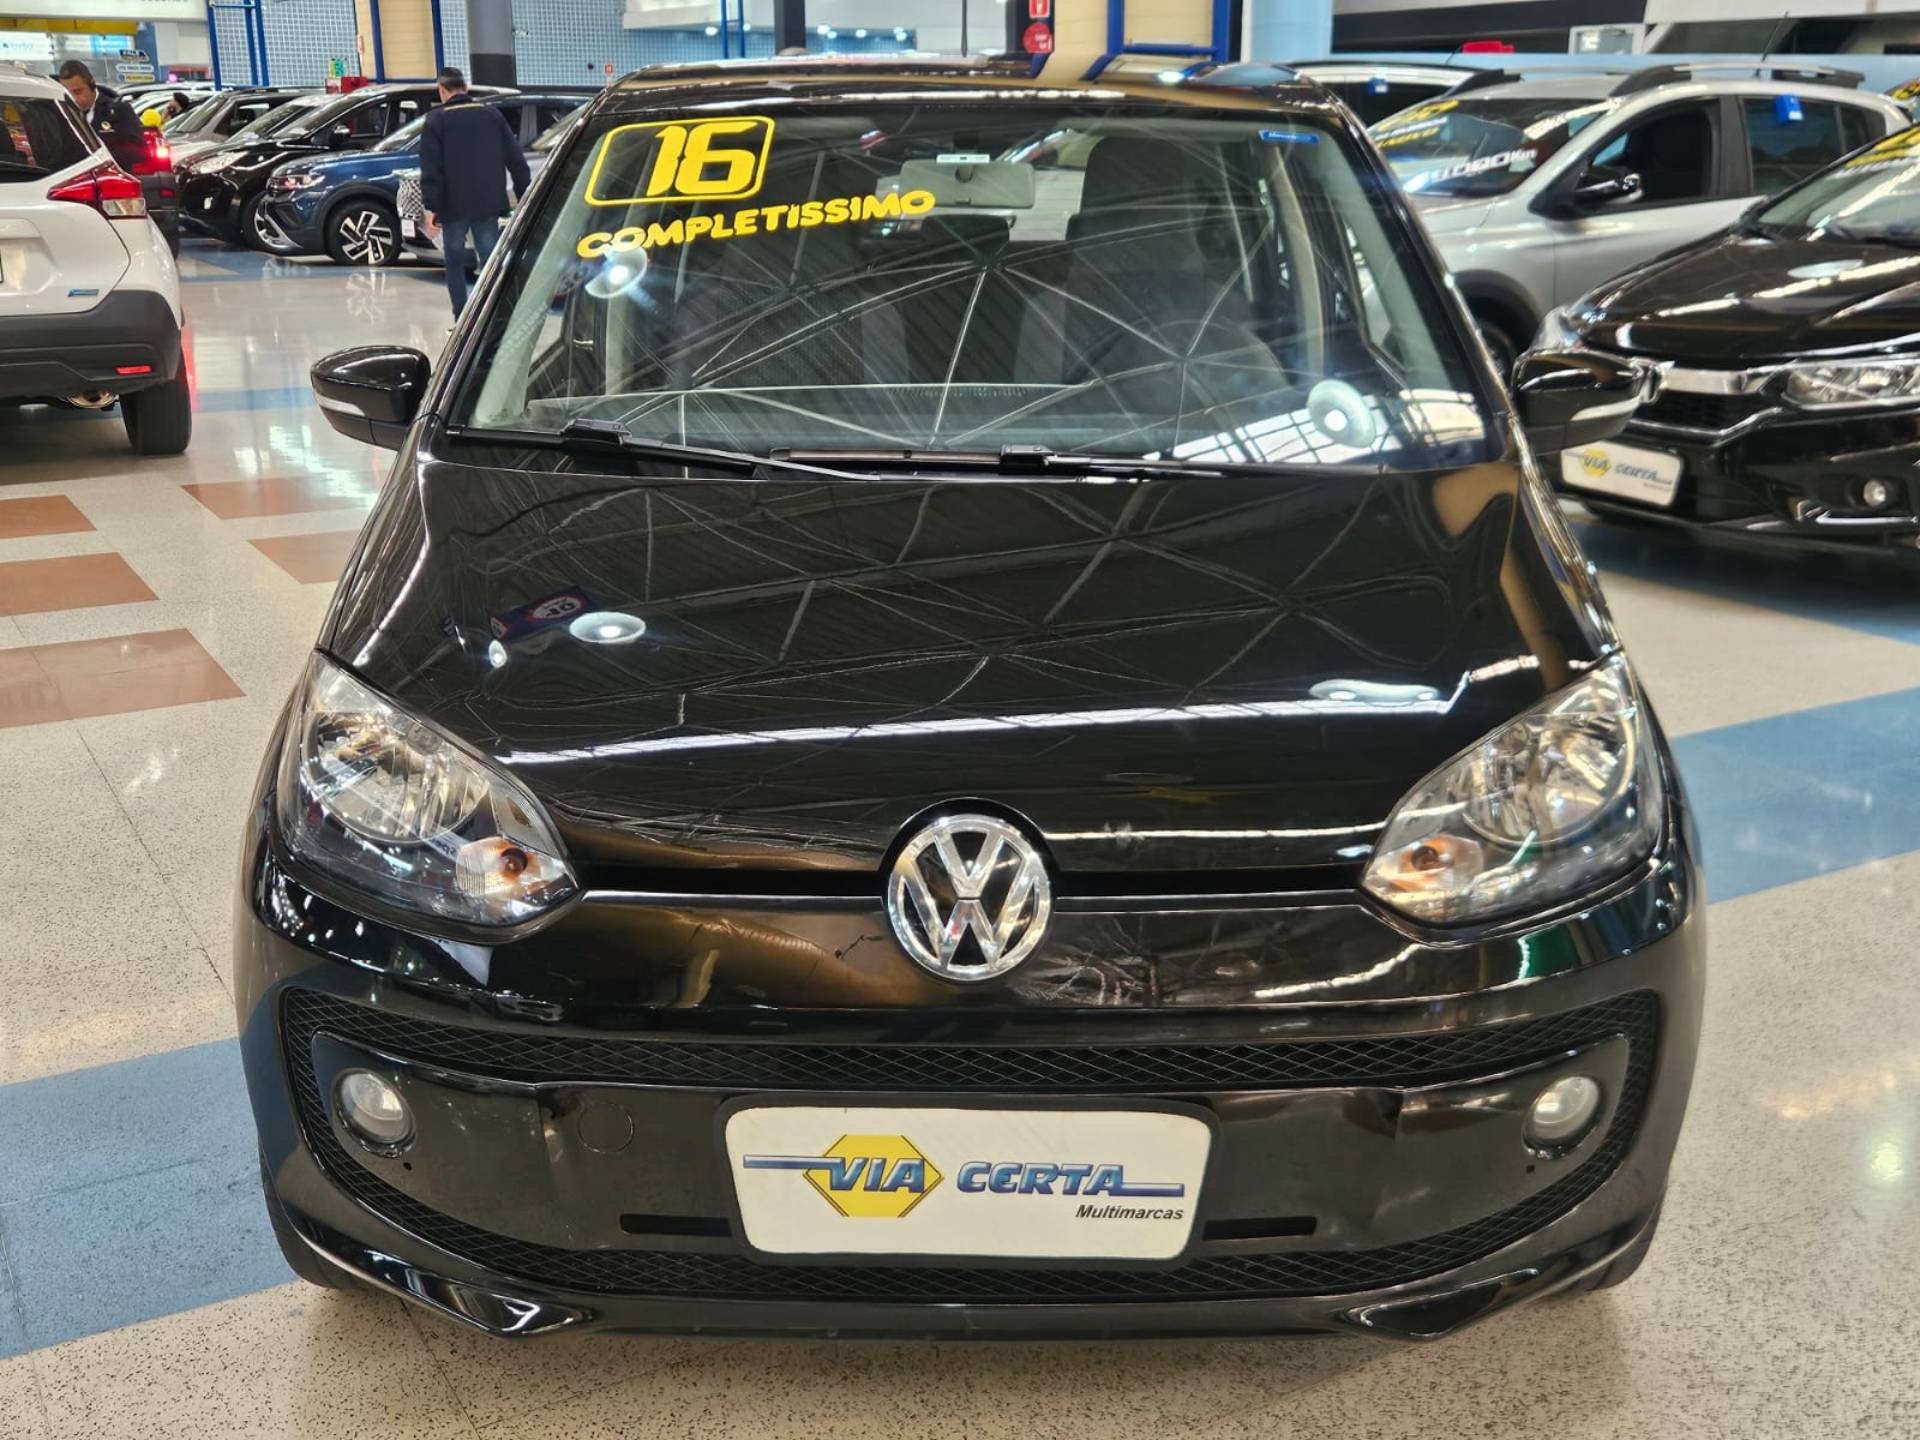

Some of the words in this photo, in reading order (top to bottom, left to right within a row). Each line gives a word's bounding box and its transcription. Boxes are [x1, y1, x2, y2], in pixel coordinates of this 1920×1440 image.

[645, 120, 758, 198] 16
[576, 190, 936, 259] COMPLETISSIMO
[824, 1157, 926, 1193] VIA
[957, 1160, 1125, 1196] CERTA
[1075, 1203, 1185, 1221] Multimarcas
